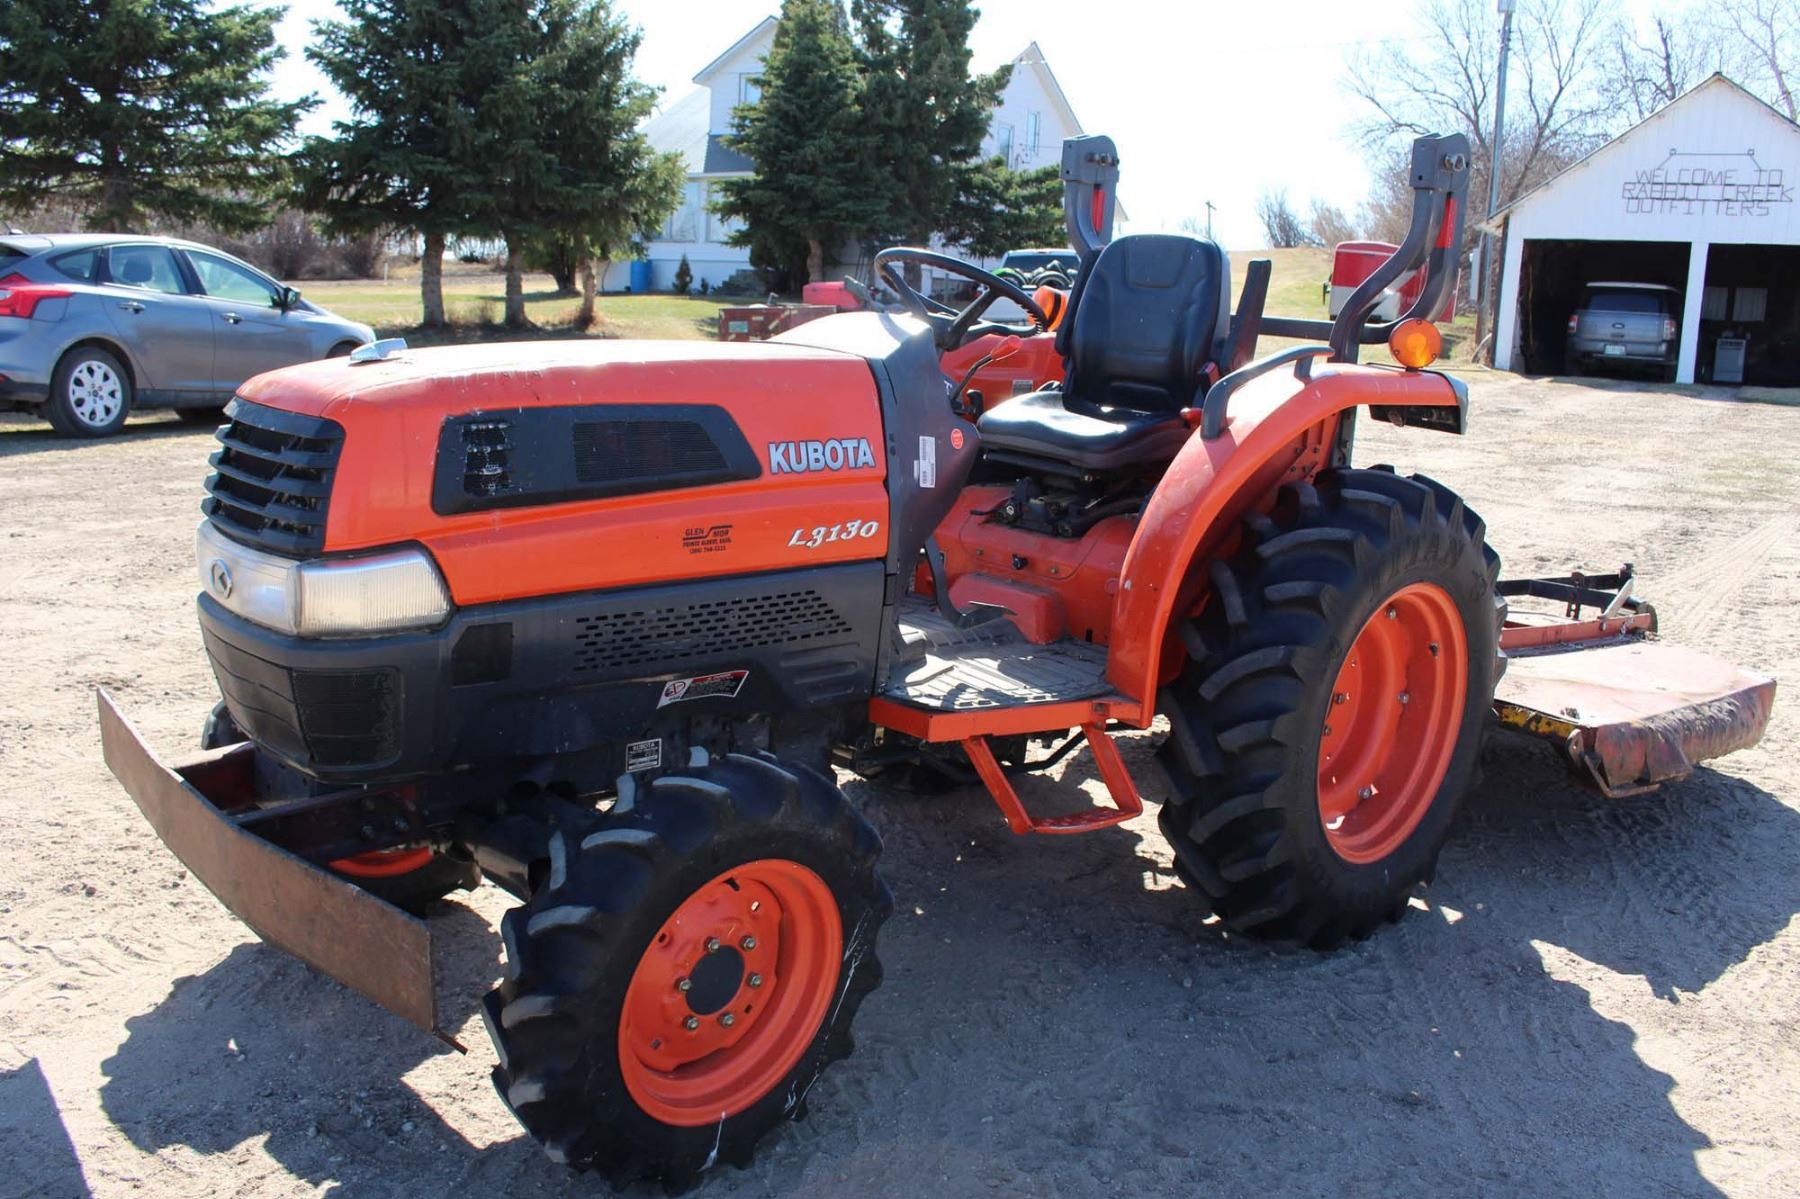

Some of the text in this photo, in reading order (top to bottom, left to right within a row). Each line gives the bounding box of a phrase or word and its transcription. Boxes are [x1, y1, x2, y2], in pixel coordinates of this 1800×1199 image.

[1635, 168, 1783, 187] WELCOME TO
[1622, 182, 1795, 202] RABBIT CREEK
[1626, 198, 1770, 216] OUTFITTERS
[768, 438, 876, 474] KUBOTA
[685, 527, 705, 537] GLEN
[787, 519, 880, 548] L3130
